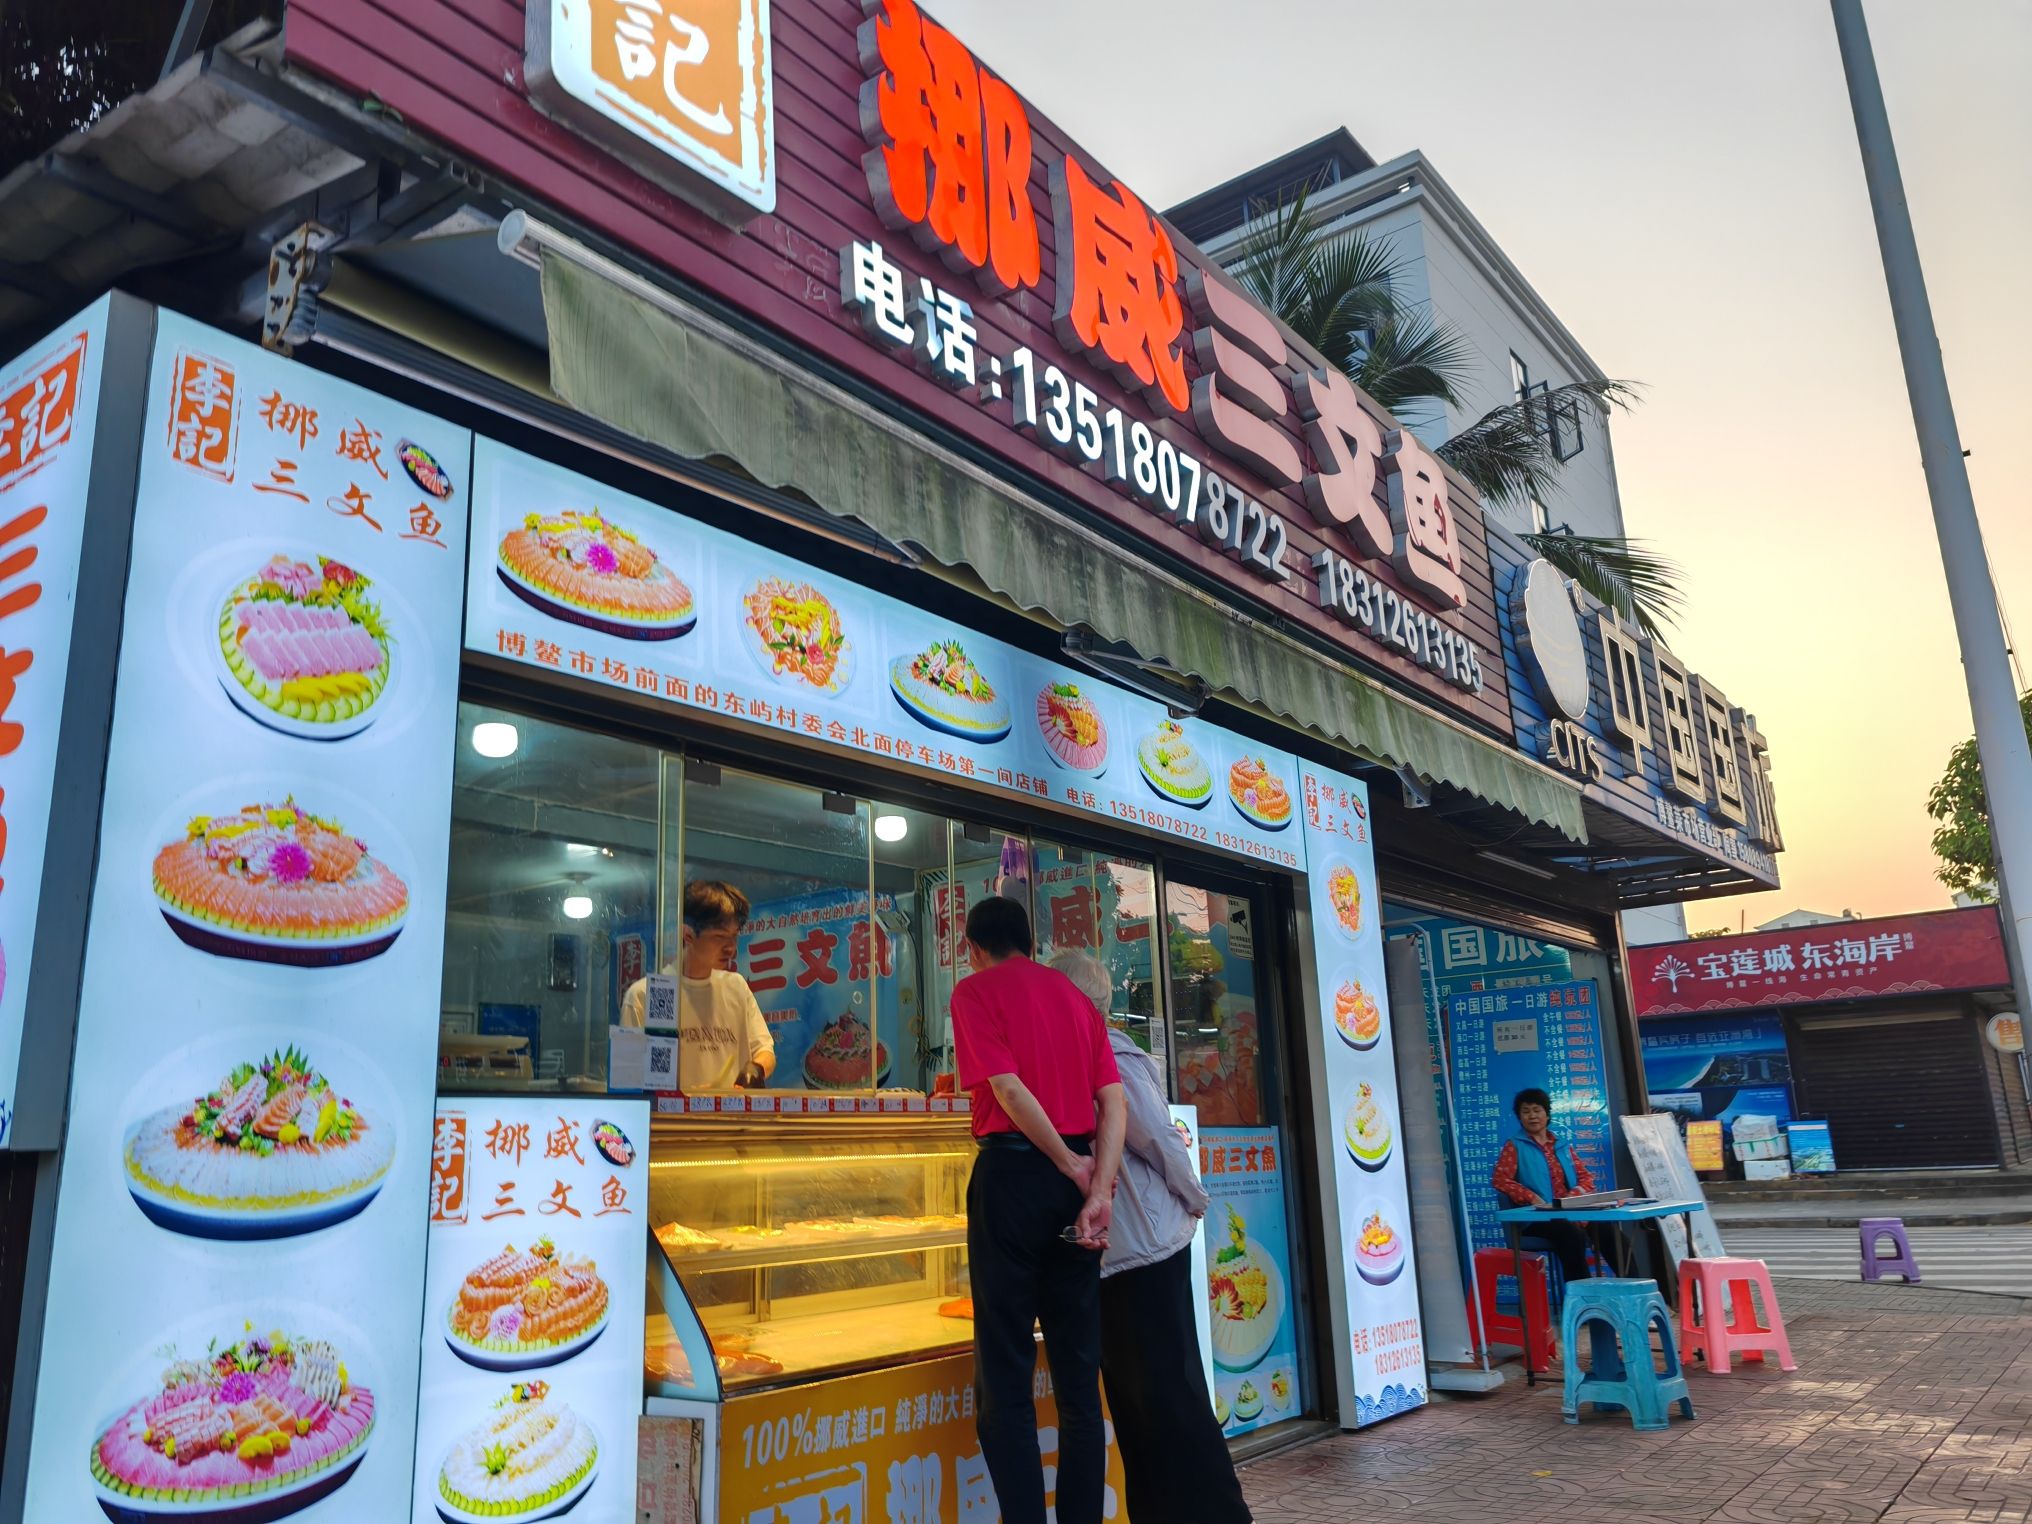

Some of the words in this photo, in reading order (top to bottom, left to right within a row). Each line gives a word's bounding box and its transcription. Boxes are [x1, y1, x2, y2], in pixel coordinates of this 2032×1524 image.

[860, 0, 1468, 609] 挪威三文鱼
[0, 368, 72, 465] 記
[174, 358, 236, 472] 李記
[259, 390, 390, 481] 挪威
[251, 459, 448, 550] 三文鱼
[1318, 548, 1483, 693] 18312613135
[496, 629, 1048, 797] 博鳌市场前面的东屿村委会北面停车场第一间店铺
[1109, 799, 1208, 842] 13518078722
[1215, 831, 1297, 867] 18312613135
[1550, 718, 1603, 782] CITS
[1325, 814, 1368, 844] 三文鱼
[1697, 943, 1796, 981] 宝莲城
[1800, 932, 1903, 969] 东海岸
[484, 1115, 586, 1168] 挪威
[481, 1174, 633, 1221] 三文鱼
[895, 1383, 978, 1434] 純淨的大自
